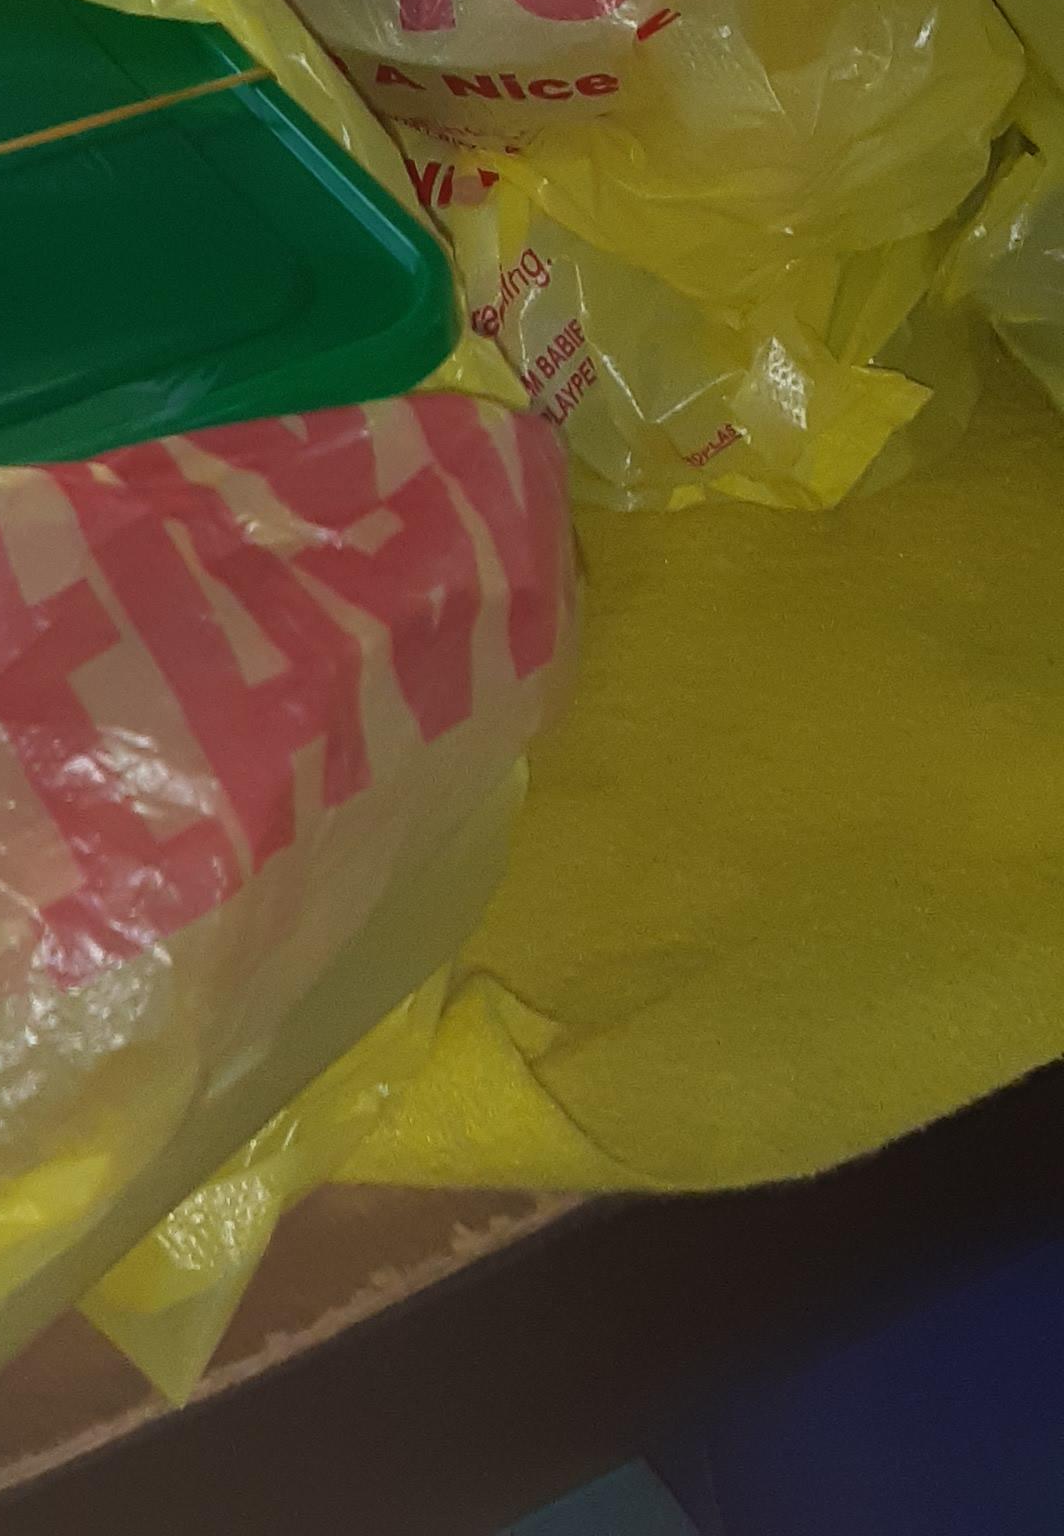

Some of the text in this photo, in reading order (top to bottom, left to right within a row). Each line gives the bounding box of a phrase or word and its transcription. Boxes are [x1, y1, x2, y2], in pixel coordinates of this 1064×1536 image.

[374, 63, 620, 101] A Nice
[536, 318, 585, 378] BABIE
